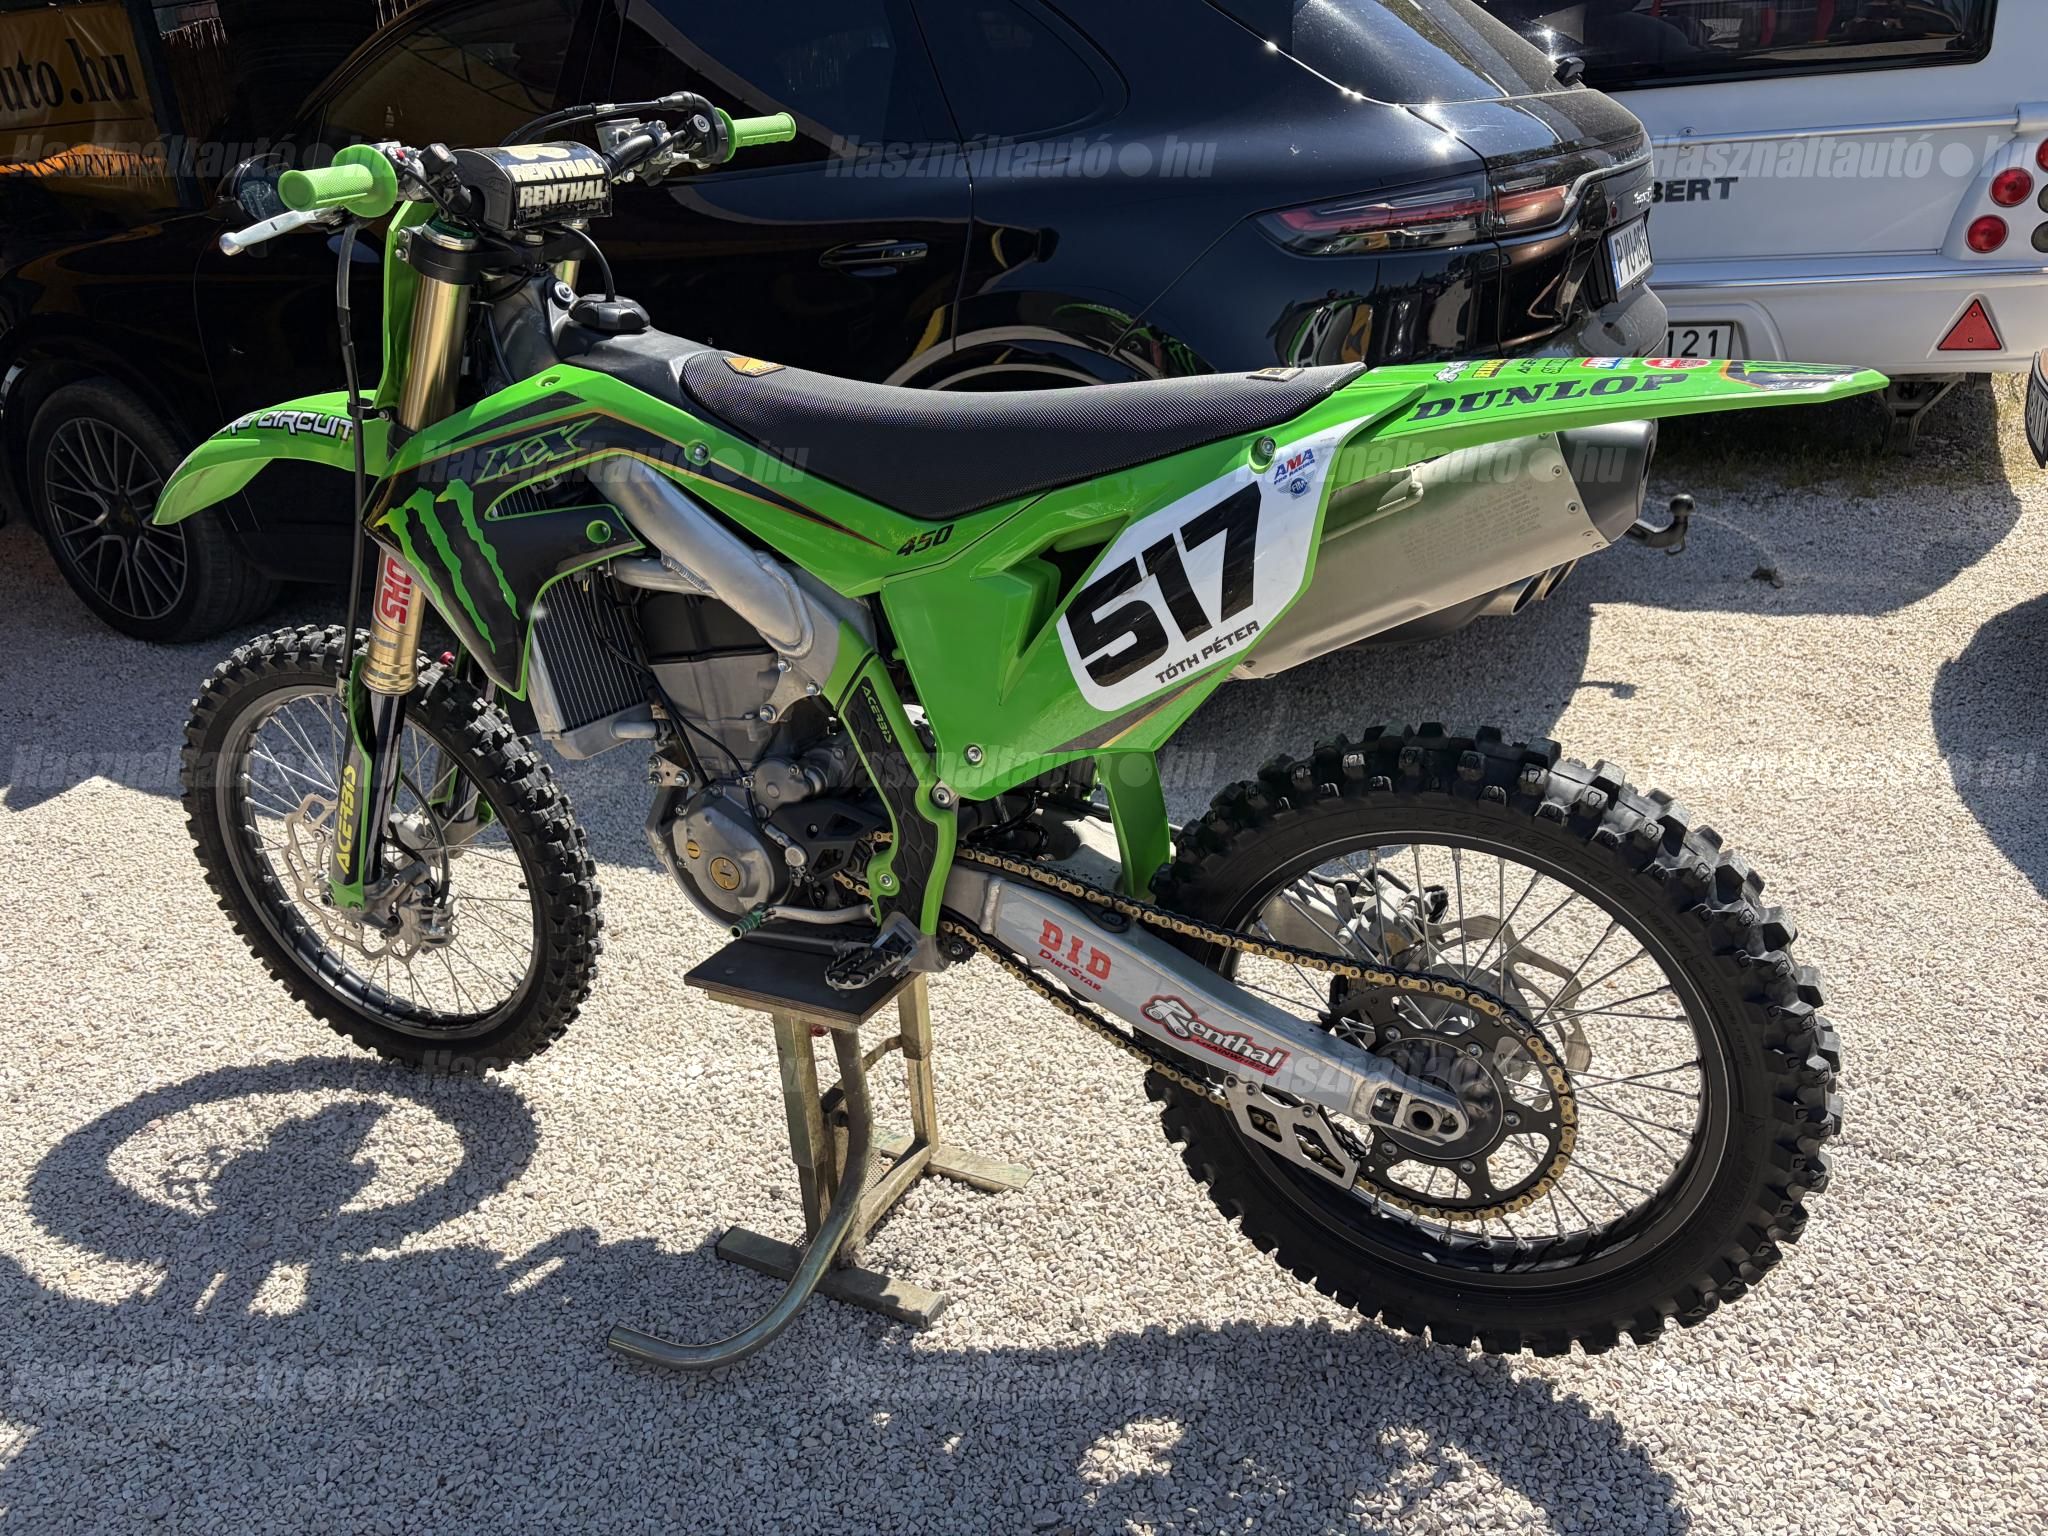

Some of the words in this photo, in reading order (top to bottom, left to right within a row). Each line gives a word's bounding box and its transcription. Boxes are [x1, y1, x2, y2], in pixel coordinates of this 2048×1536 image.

[0, 38, 139, 112] uto.hu
[507, 158, 605, 182] RENTHAL
[519, 179, 607, 208] RENTHAL
[257, 410, 353, 441] CIRCUIT
[1407, 374, 1689, 422] DUNLOP
[1274, 448, 1314, 480] AMA
[896, 523, 955, 556] 450
[1065, 480, 1262, 688] 517
[1155, 653, 1200, 684] TÓTH
[1201, 620, 1260, 660] PÉTER
[336, 764, 356, 875] ACERBIS
[1038, 918, 1112, 980] D.I.D
[1145, 999, 1284, 1068] Renthal
